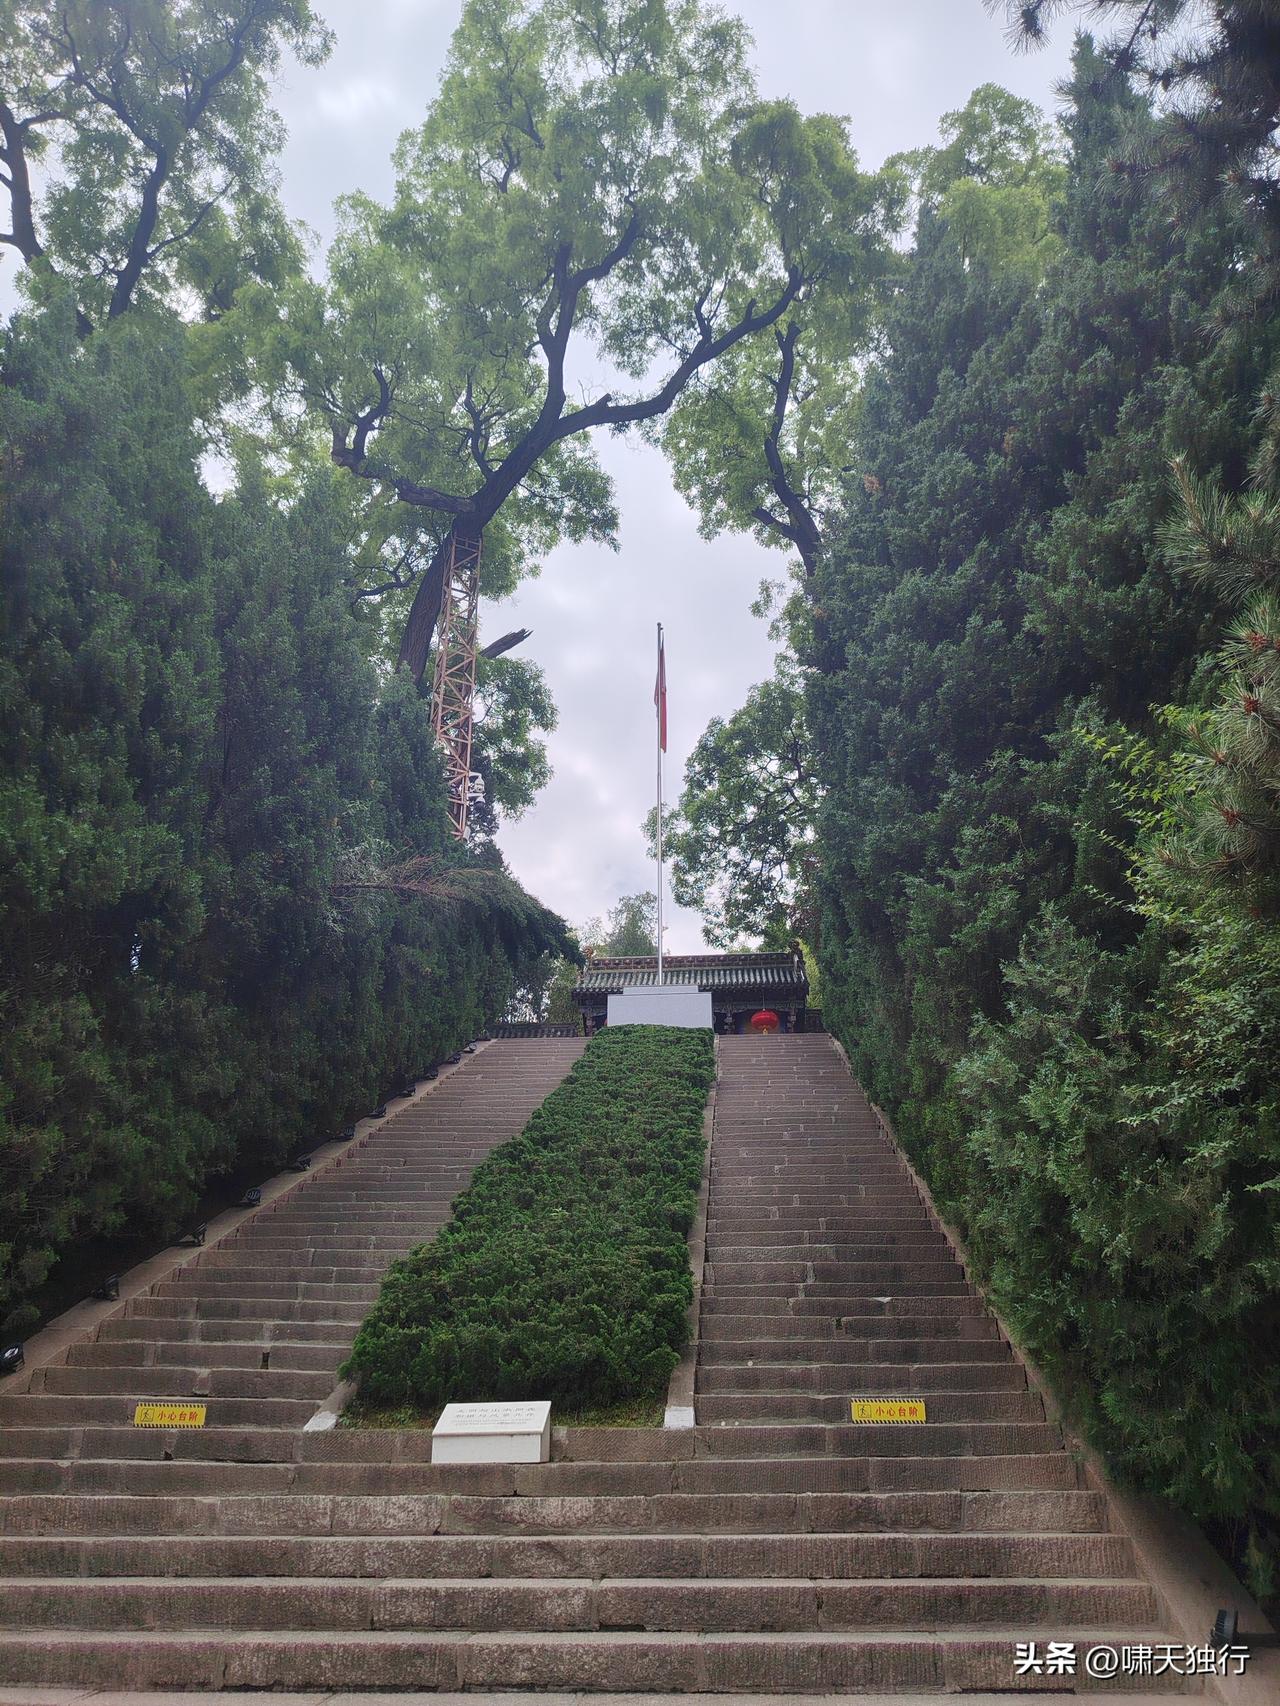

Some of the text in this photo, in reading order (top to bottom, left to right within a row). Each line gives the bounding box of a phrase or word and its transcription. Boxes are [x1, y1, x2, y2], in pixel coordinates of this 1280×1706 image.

[158, 1410, 198, 1422] 小心台阶
[875, 1406, 918, 1417] 小心台阶
